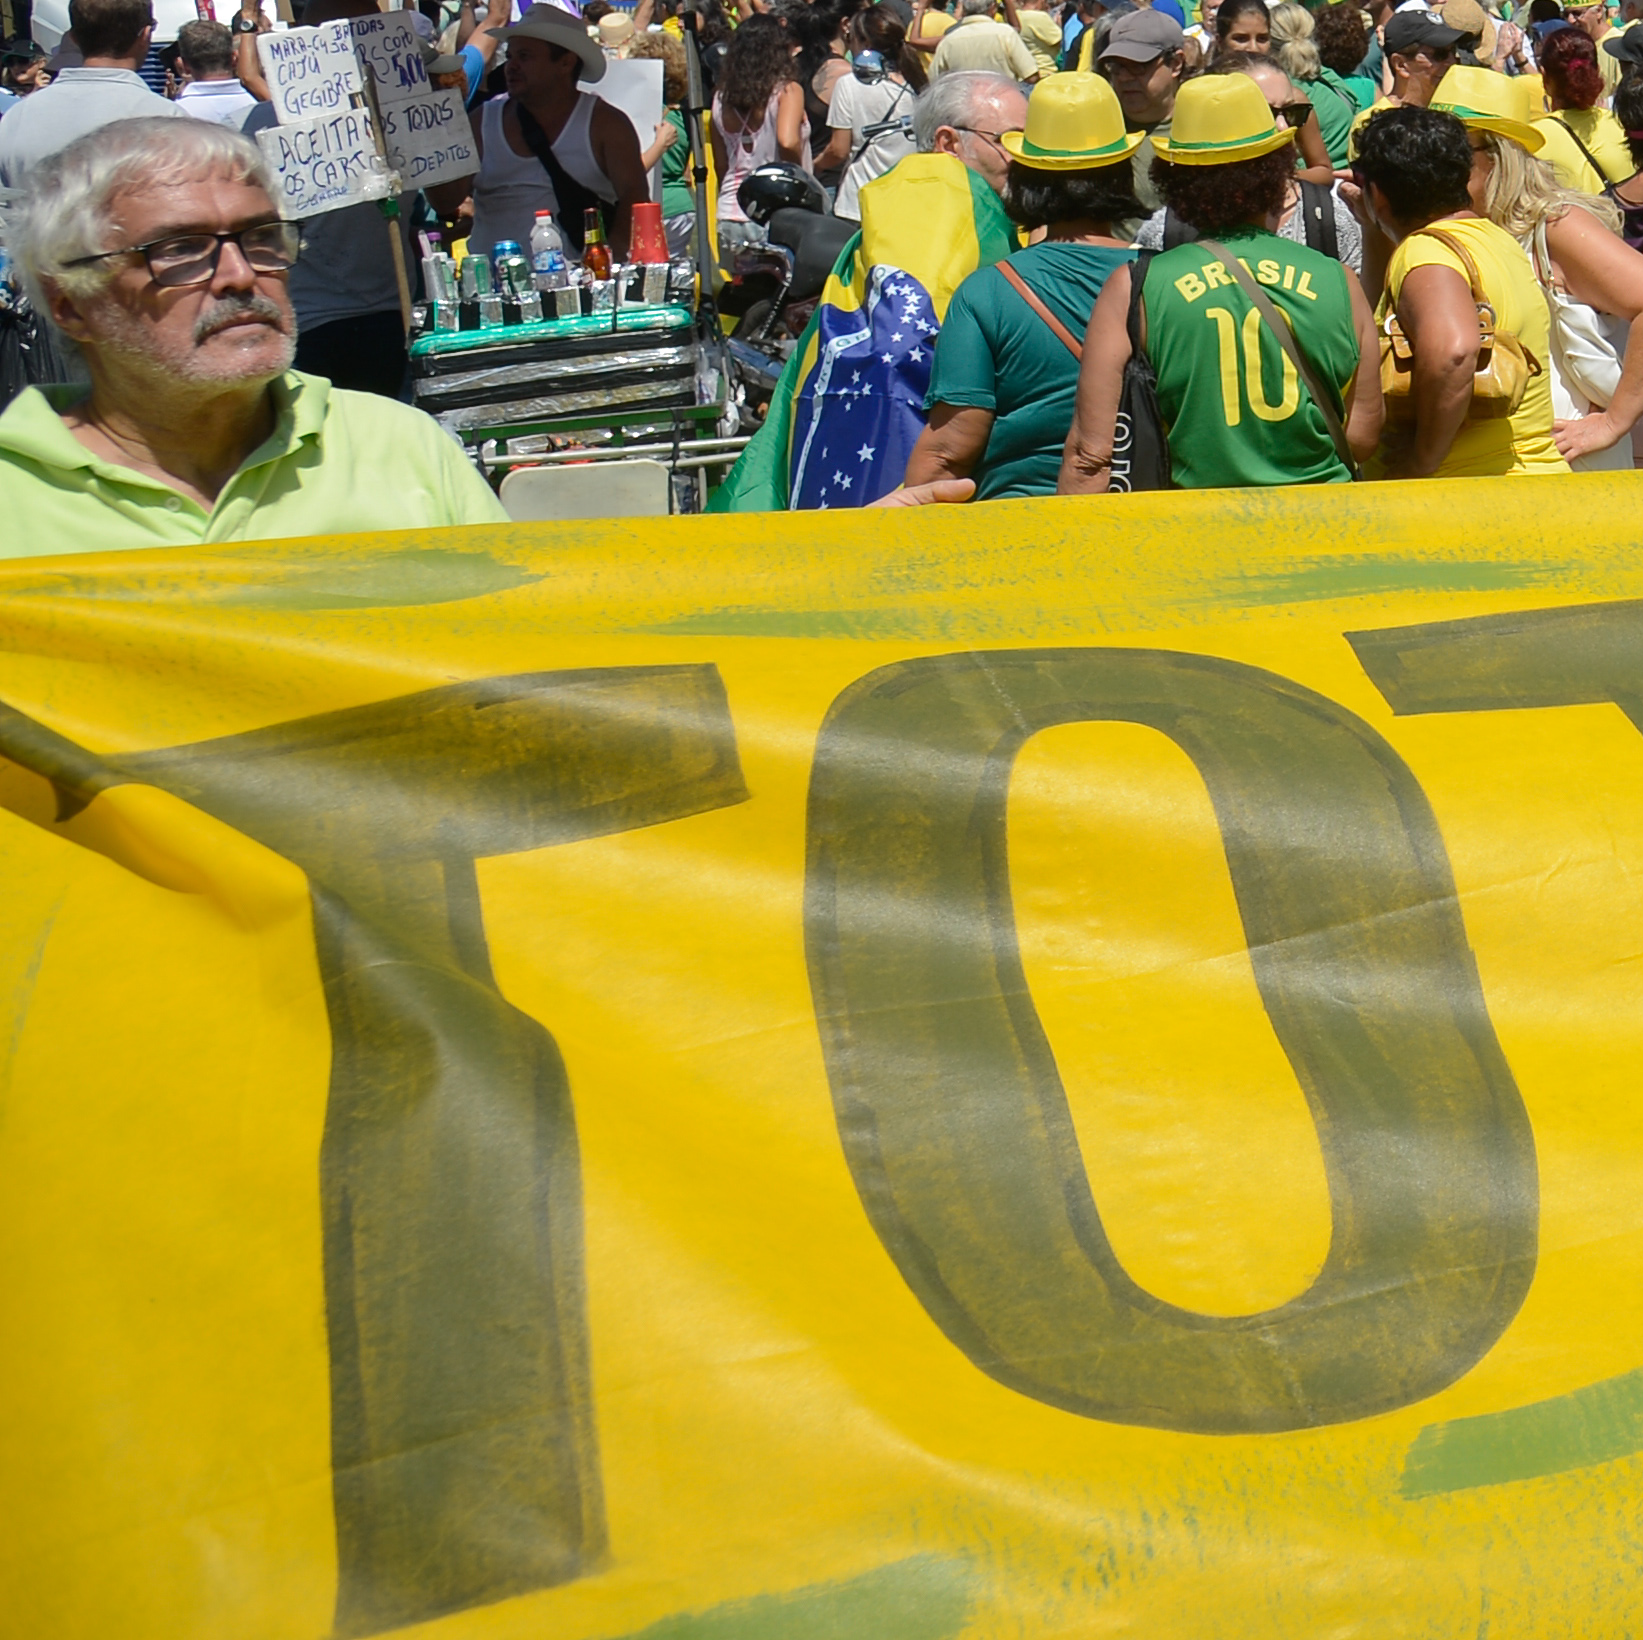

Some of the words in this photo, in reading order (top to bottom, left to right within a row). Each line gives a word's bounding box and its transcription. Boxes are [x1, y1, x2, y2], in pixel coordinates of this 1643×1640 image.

[402, 98, 454, 134] TODOS
[284, 173, 306, 196] OS
[1205, 304, 1300, 428] 10
